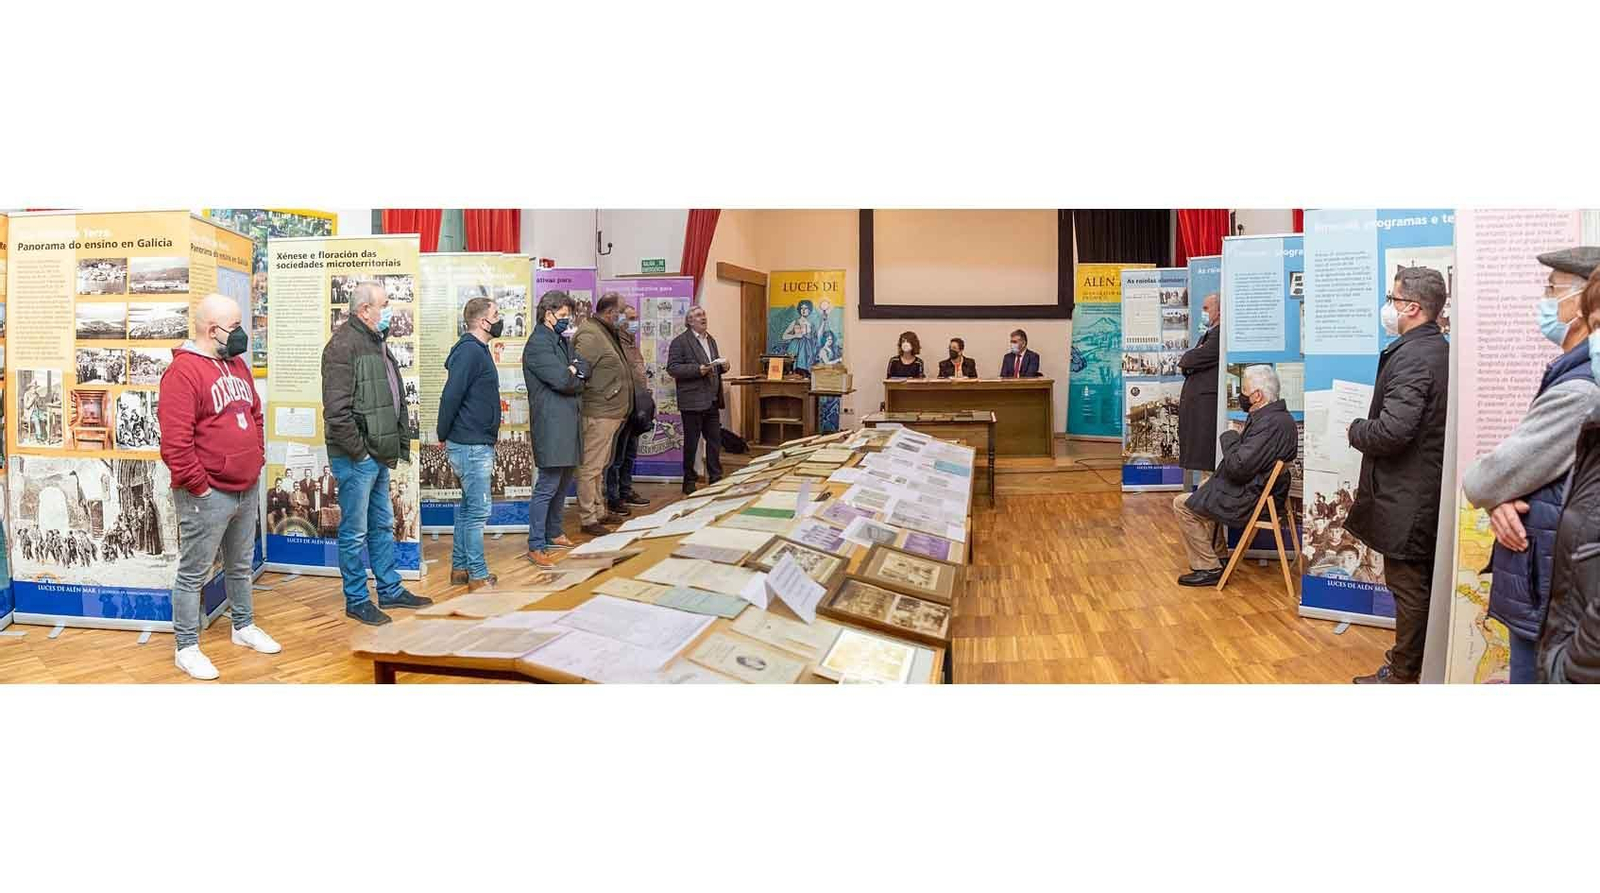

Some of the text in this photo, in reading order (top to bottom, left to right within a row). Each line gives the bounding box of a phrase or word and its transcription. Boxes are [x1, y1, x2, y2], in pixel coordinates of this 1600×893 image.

[1431, 217, 1438, 225] e
[17, 238, 173, 251] Panorama do ensino en Galicia
[276, 251, 307, 260] Xénese
[318, 250, 358, 260] floración
[361, 249, 377, 258] das
[276, 258, 401, 269] sociedades microterritoriais
[783, 281, 839, 293] LUCES DE
[65, 585, 82, 593] ALÉN
[1357, 581, 1373, 590] ALÉN
